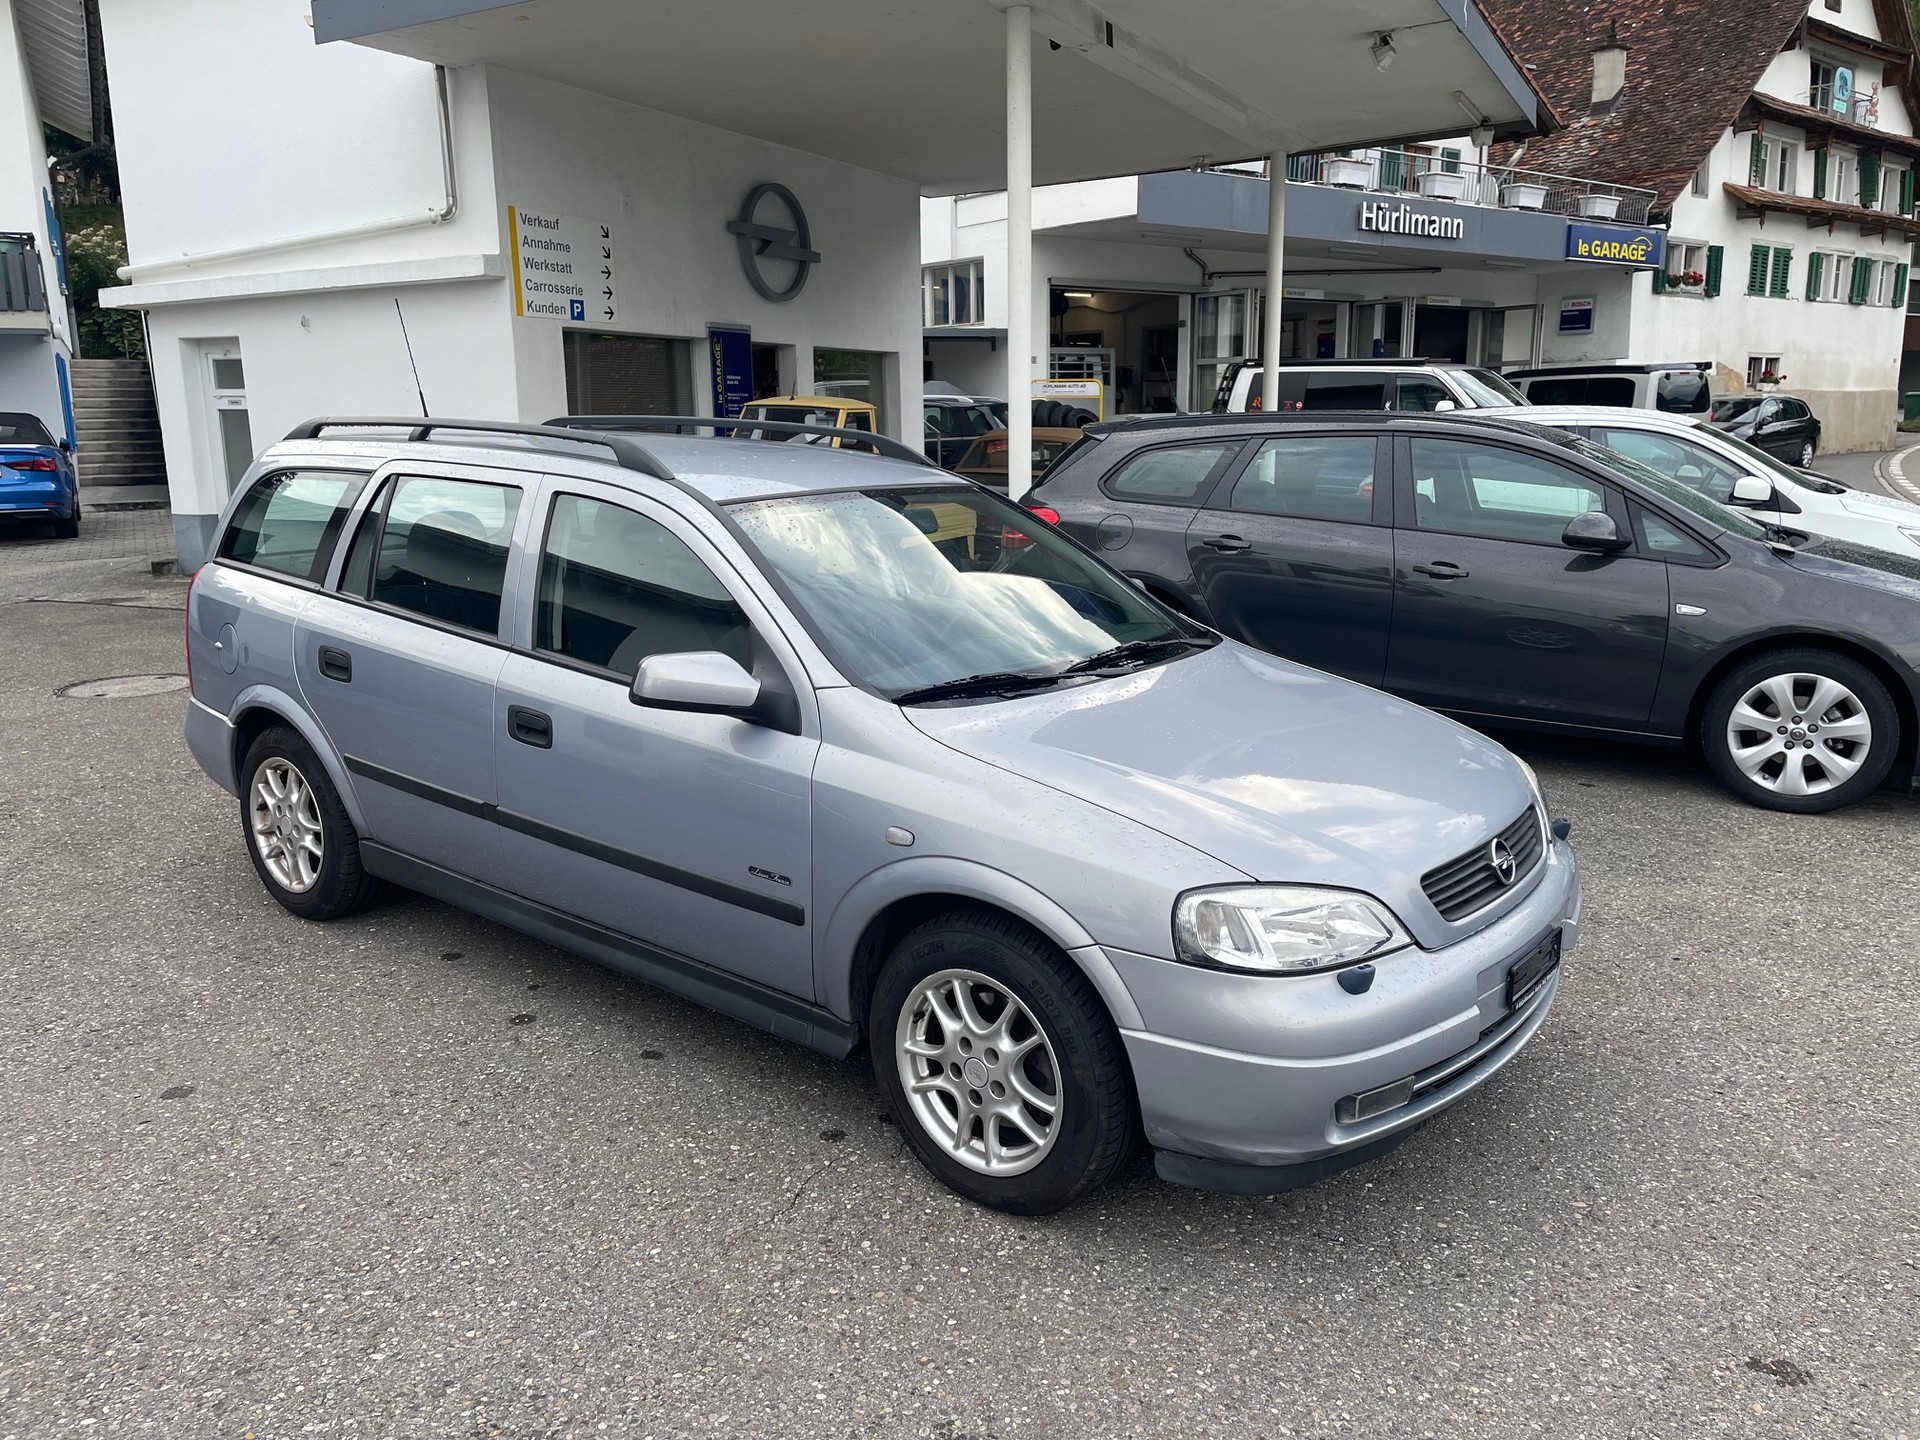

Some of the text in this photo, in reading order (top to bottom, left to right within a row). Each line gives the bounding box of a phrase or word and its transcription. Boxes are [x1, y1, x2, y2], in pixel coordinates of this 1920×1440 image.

[520, 212, 560, 231] Verkauf
[1361, 201, 1464, 239] Hürlimann
[522, 235, 571, 253] Annahme
[1577, 238, 1647, 261] le GARAGE
[523, 256, 573, 275] Werkstatt
[525, 278, 584, 296] Carrosserie
[526, 300, 582, 317] Kunden P
[715, 343, 723, 392] GARAGE
